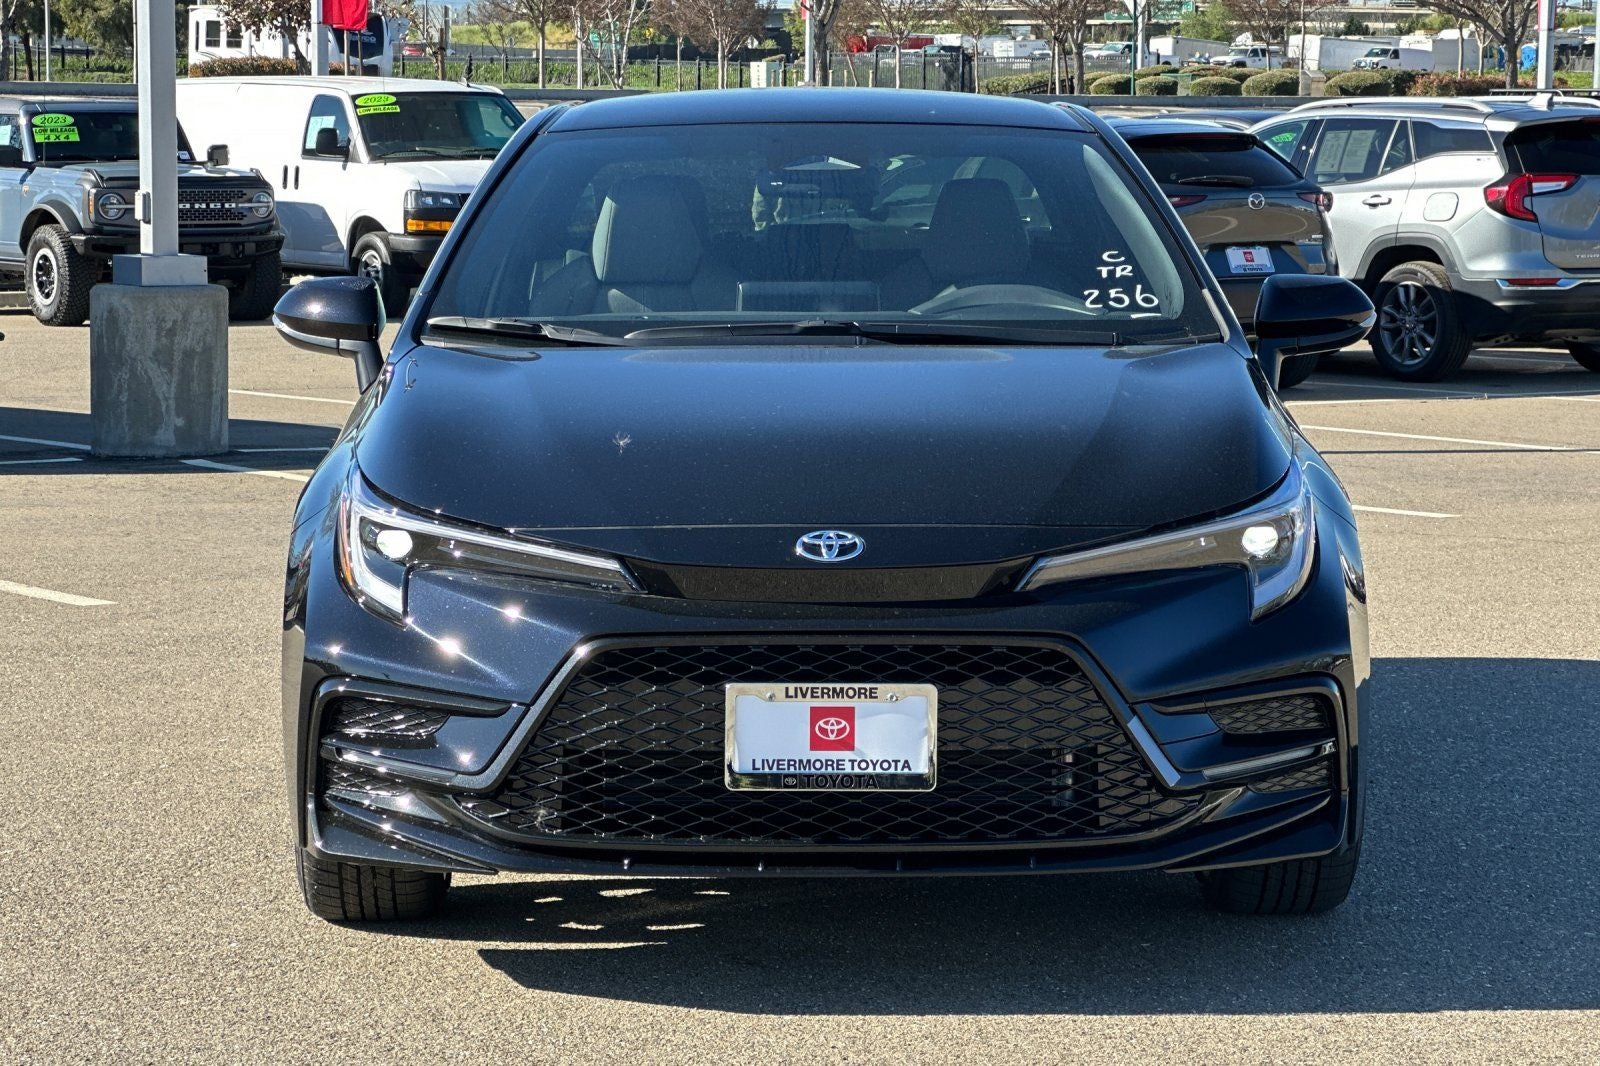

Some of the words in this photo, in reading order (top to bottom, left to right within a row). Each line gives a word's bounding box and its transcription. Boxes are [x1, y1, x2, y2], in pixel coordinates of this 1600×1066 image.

[40, 116, 67, 125] 2023
[1102, 251, 1125, 262] C
[1096, 265, 1134, 278] TR
[1083, 284, 1159, 308] 256
[784, 686, 879, 699] LIVERMORE
[751, 758, 846, 771] LIVERMORE
[848, 758, 912, 771] TOYOTA
[802, 774, 879, 789] TOYOTA
